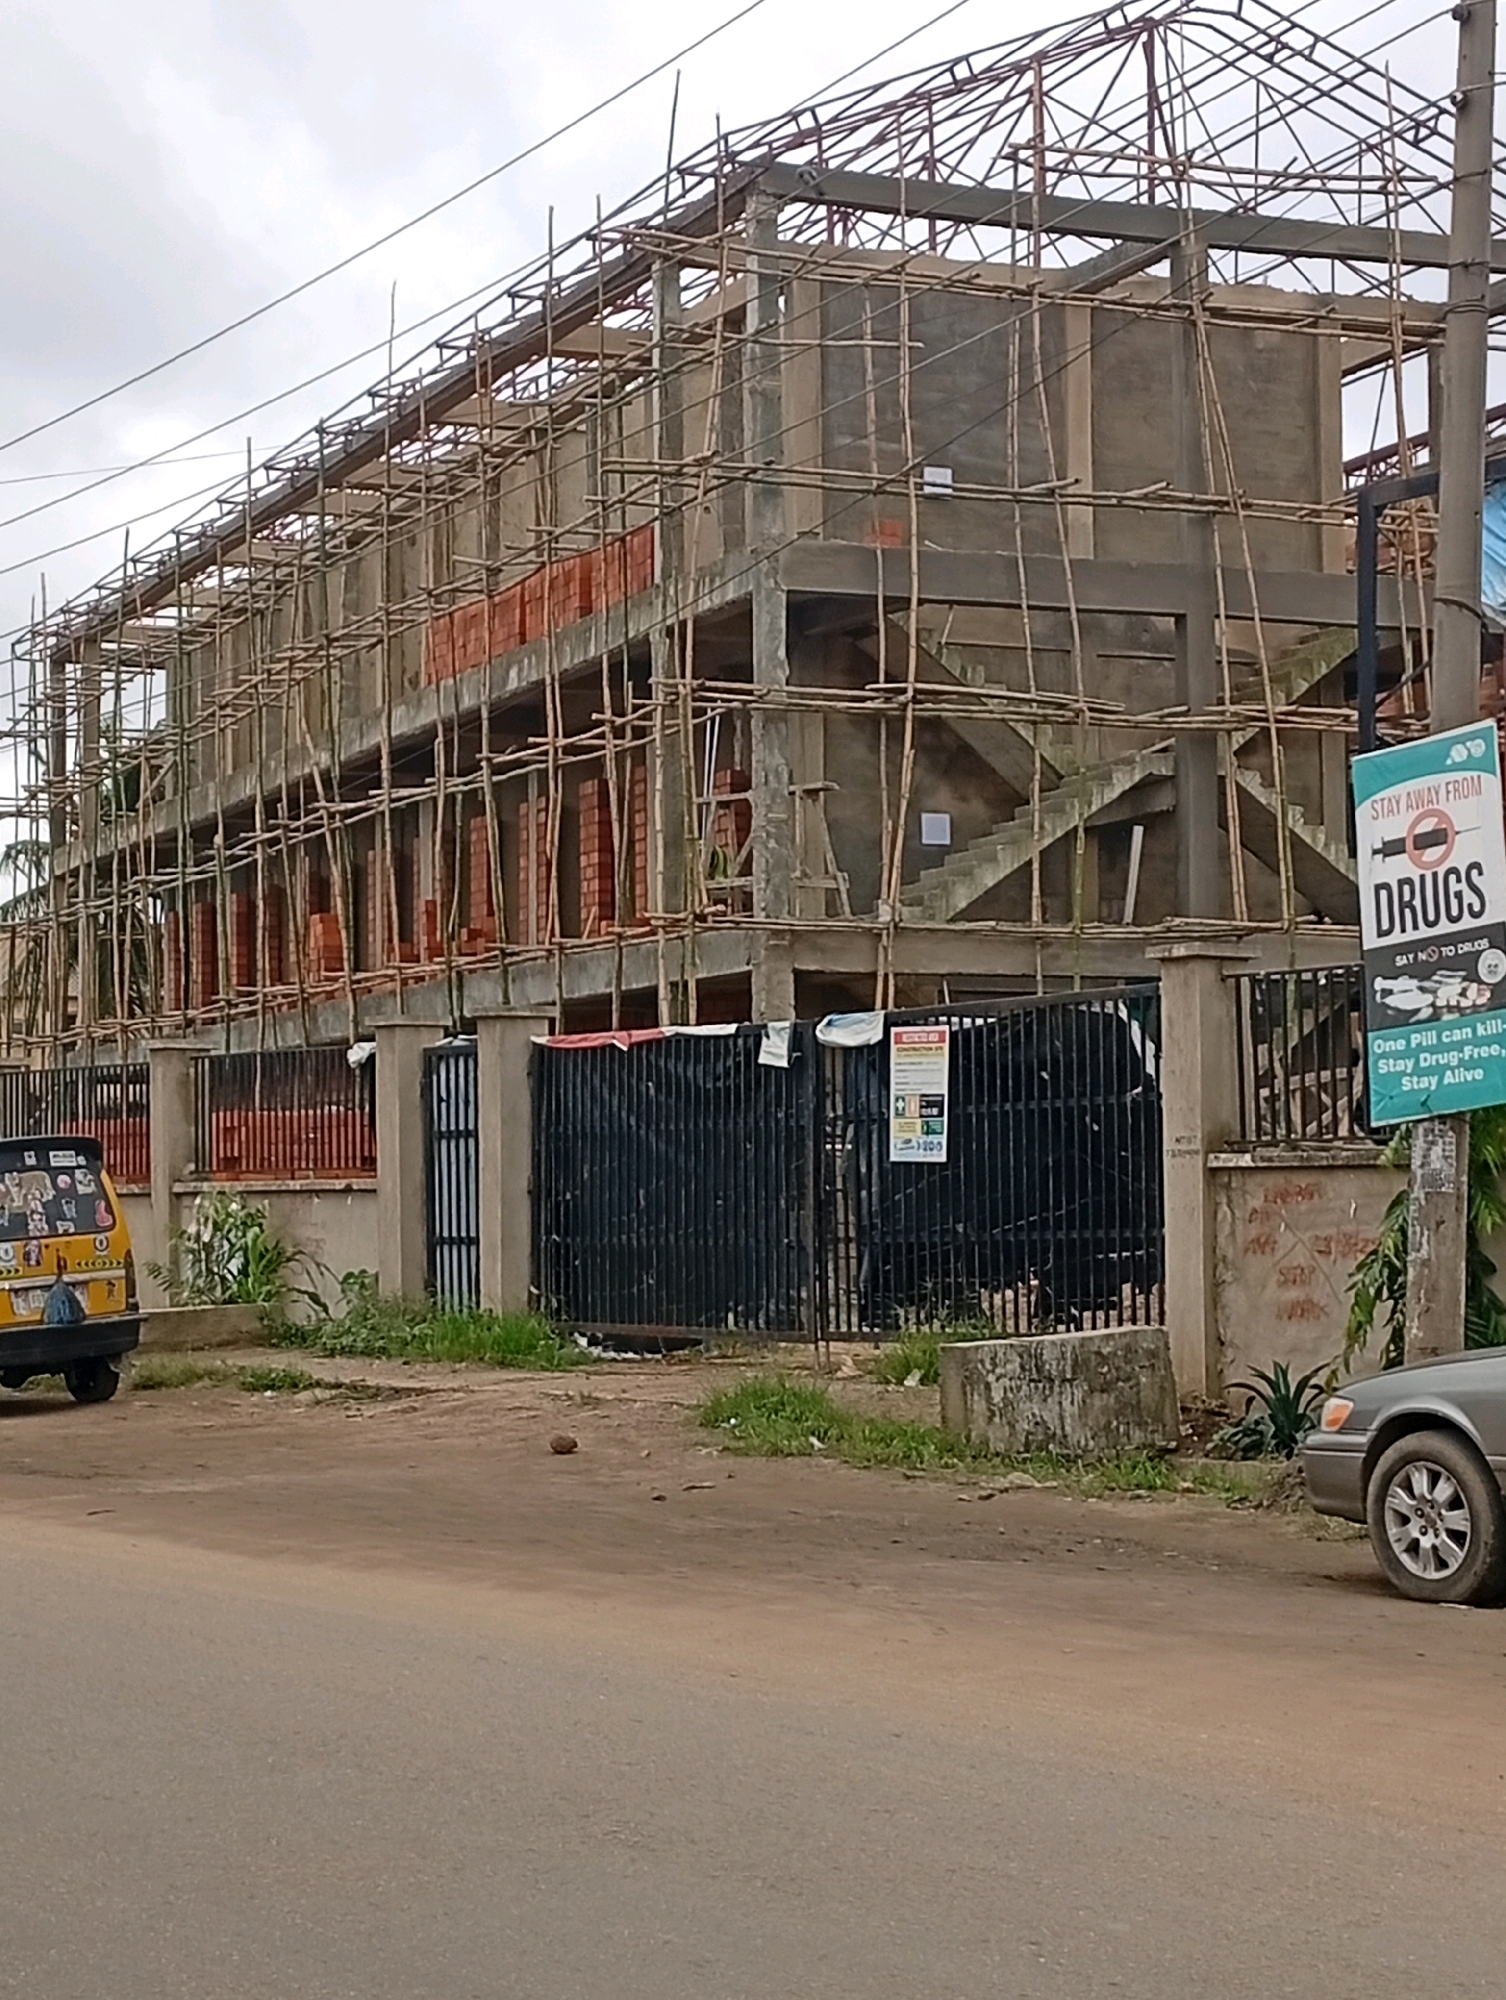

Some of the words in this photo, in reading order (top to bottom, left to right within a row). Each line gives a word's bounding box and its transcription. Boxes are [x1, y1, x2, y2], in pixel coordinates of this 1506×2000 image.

[1371, 793, 1401, 821] STAY
[1406, 783, 1441, 813] AWAY
[1445, 774, 1482, 802] FROM
[1374, 861, 1486, 938] DRUGS
[1395, 953, 1414, 966] SAY
[1440, 947, 1456, 958] TO
[1457, 938, 1490, 954] DRUGS
[1373, 1039, 1406, 1053] One
[1410, 1030, 1437, 1048] Pill
[1441, 1027, 1472, 1042] can
[1378, 1057, 1415, 1074] Stay
[1401, 1074, 1439, 1091] Stay
[1443, 1067, 1484, 1085] Alive
